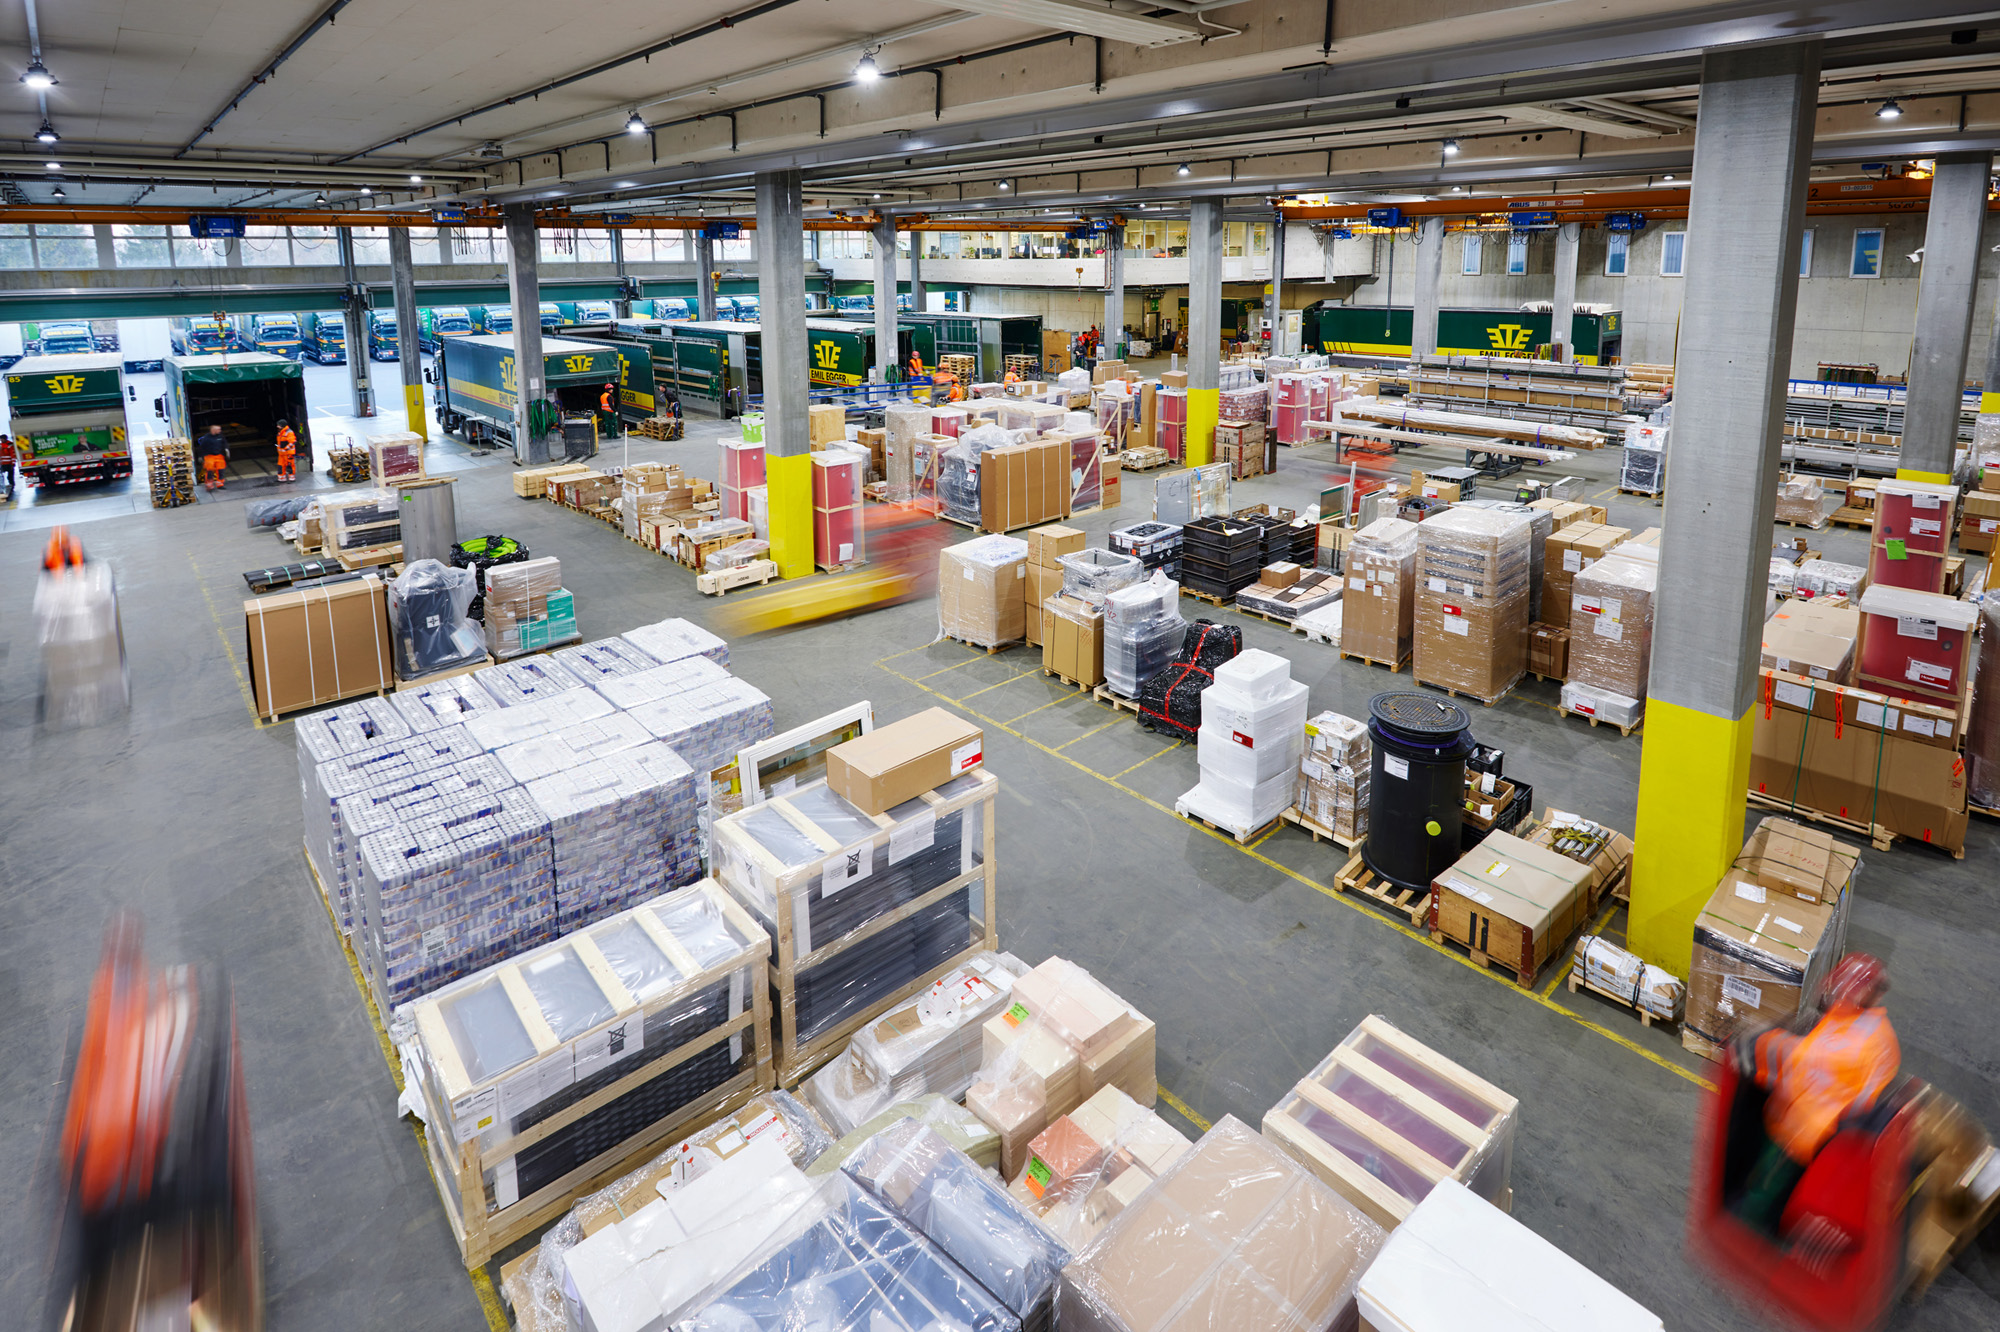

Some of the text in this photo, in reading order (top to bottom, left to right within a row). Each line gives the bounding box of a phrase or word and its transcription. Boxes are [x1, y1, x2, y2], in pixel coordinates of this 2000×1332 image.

[811, 370, 847, 384] EMIL EGGER
[1921, 674, 1935, 682] Hoval
